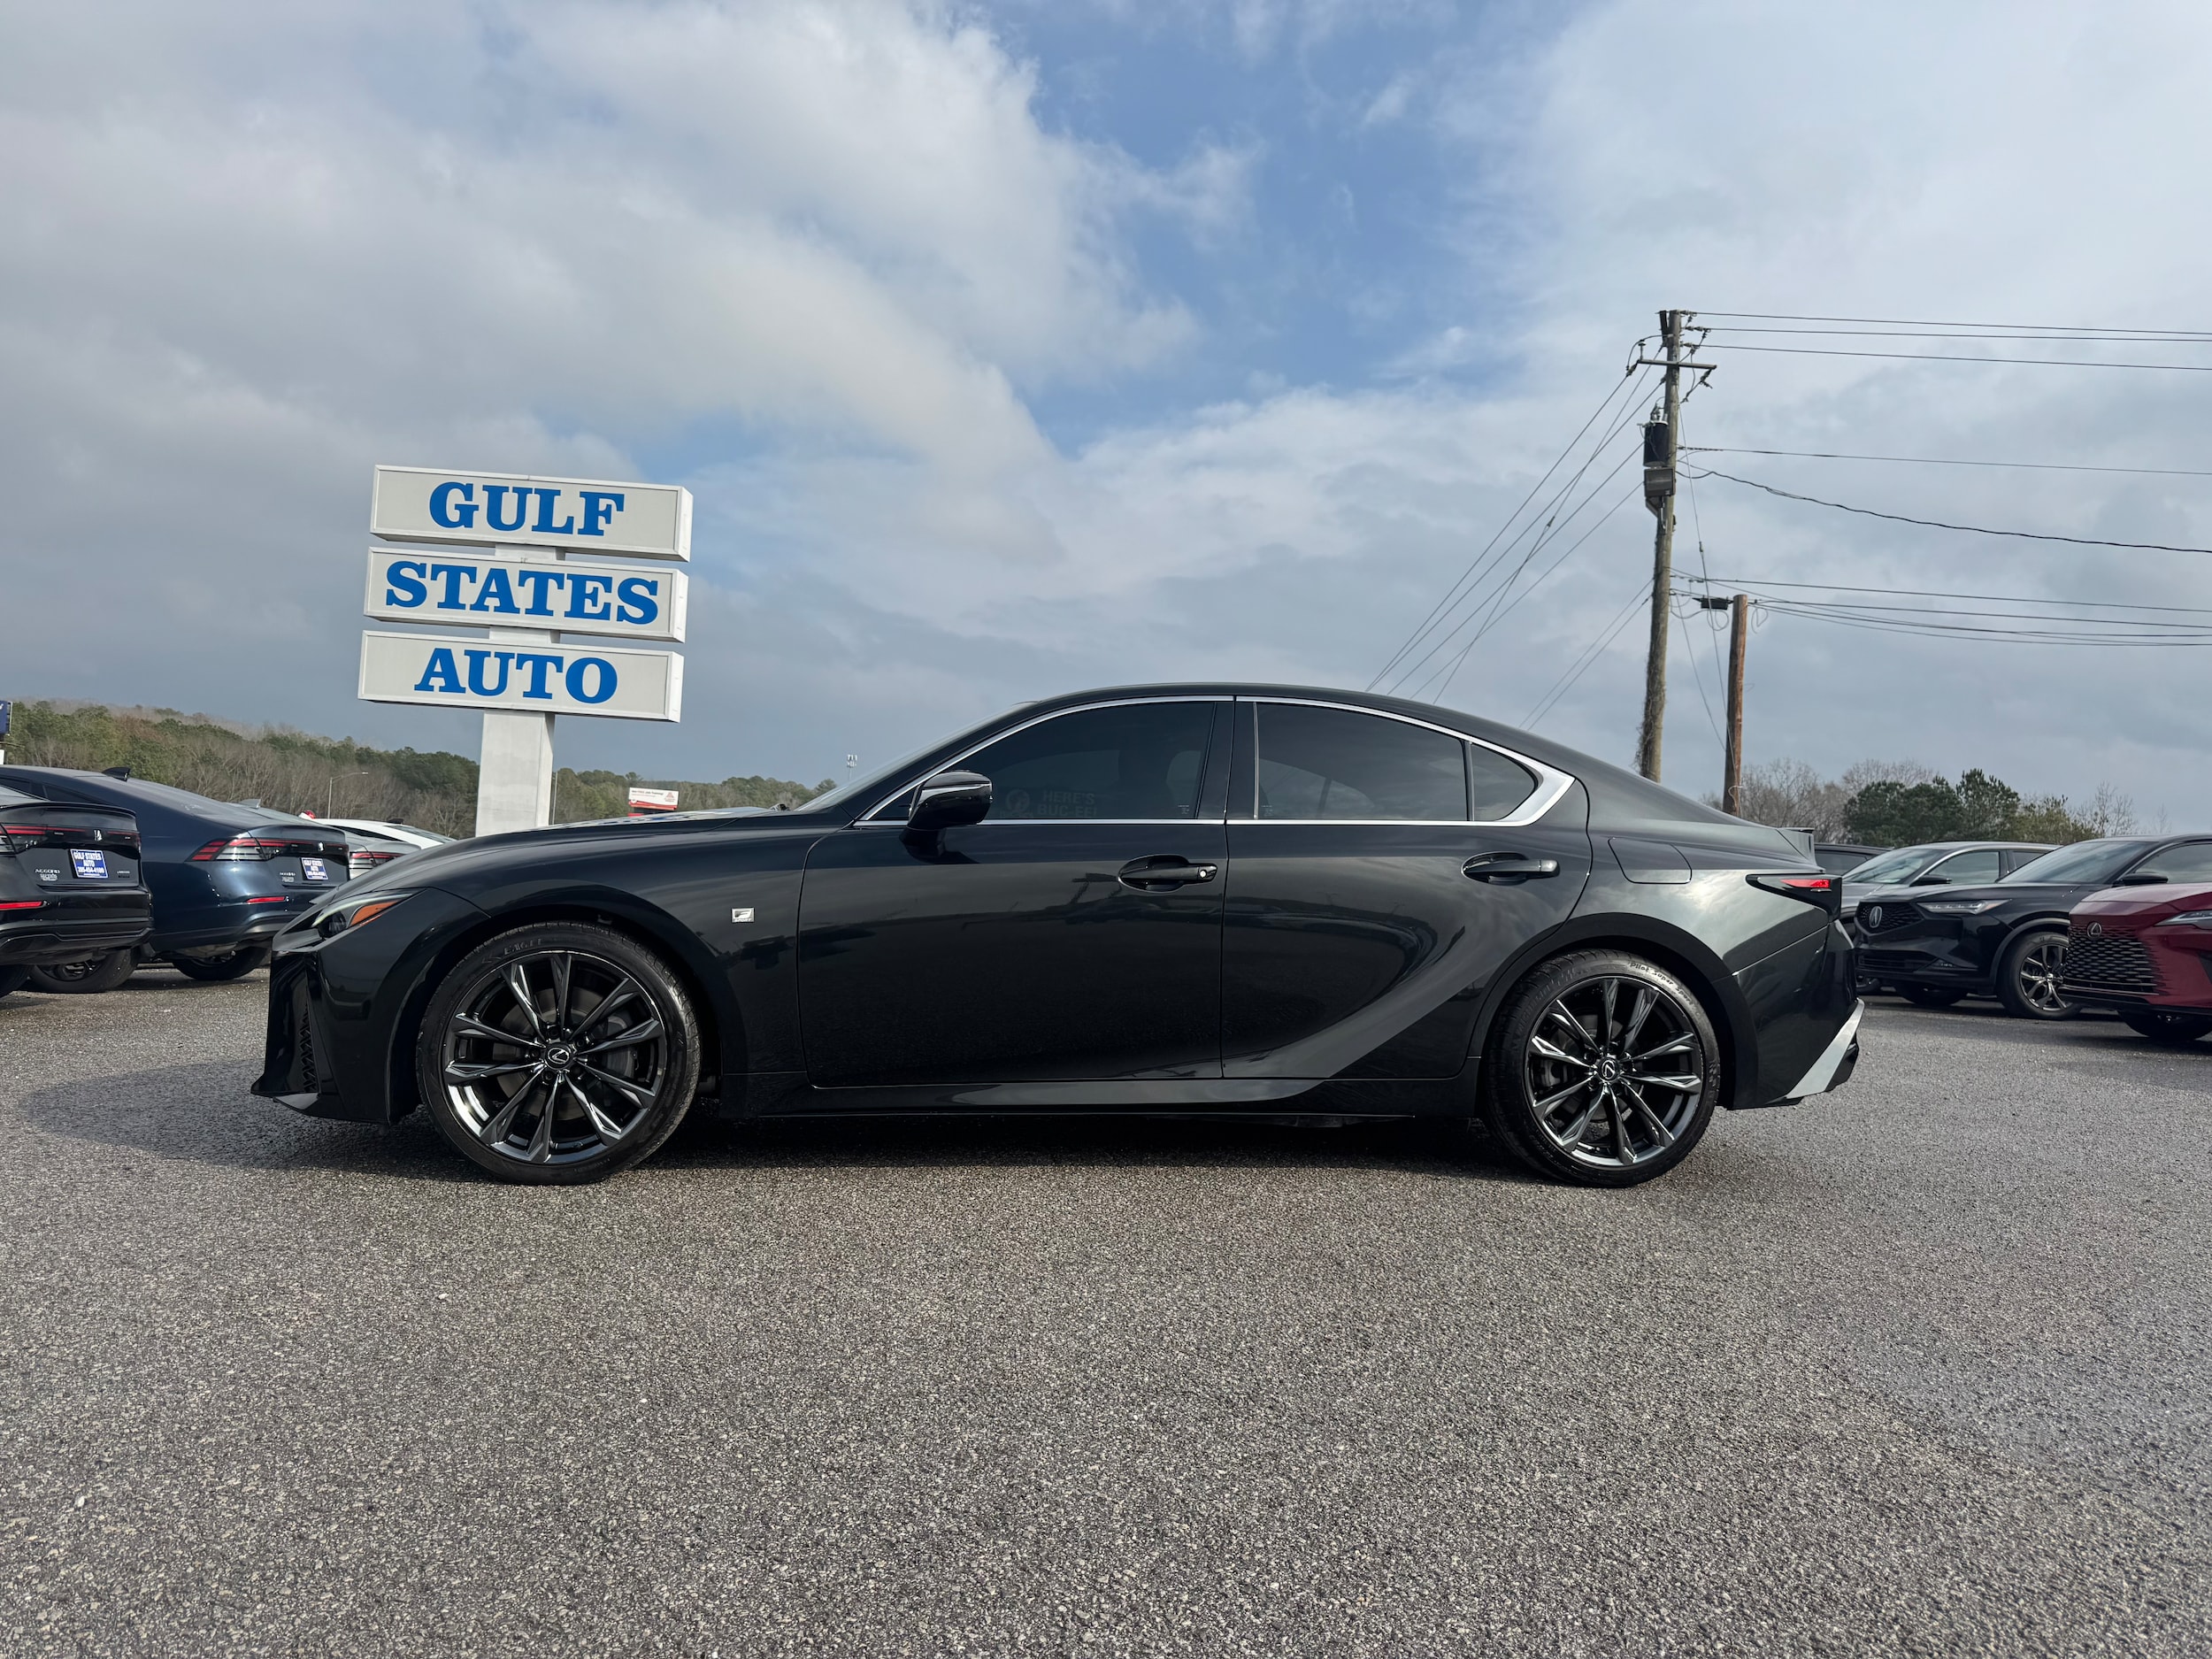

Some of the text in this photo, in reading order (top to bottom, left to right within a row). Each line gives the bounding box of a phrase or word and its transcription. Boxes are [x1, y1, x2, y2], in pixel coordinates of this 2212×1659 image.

[429, 481, 625, 536] GULF
[386, 561, 658, 625] STATES
[414, 648, 618, 704] AUTO
[1042, 790, 1095, 805] HERE'S
[1630, 962, 1649, 972] Pilot
